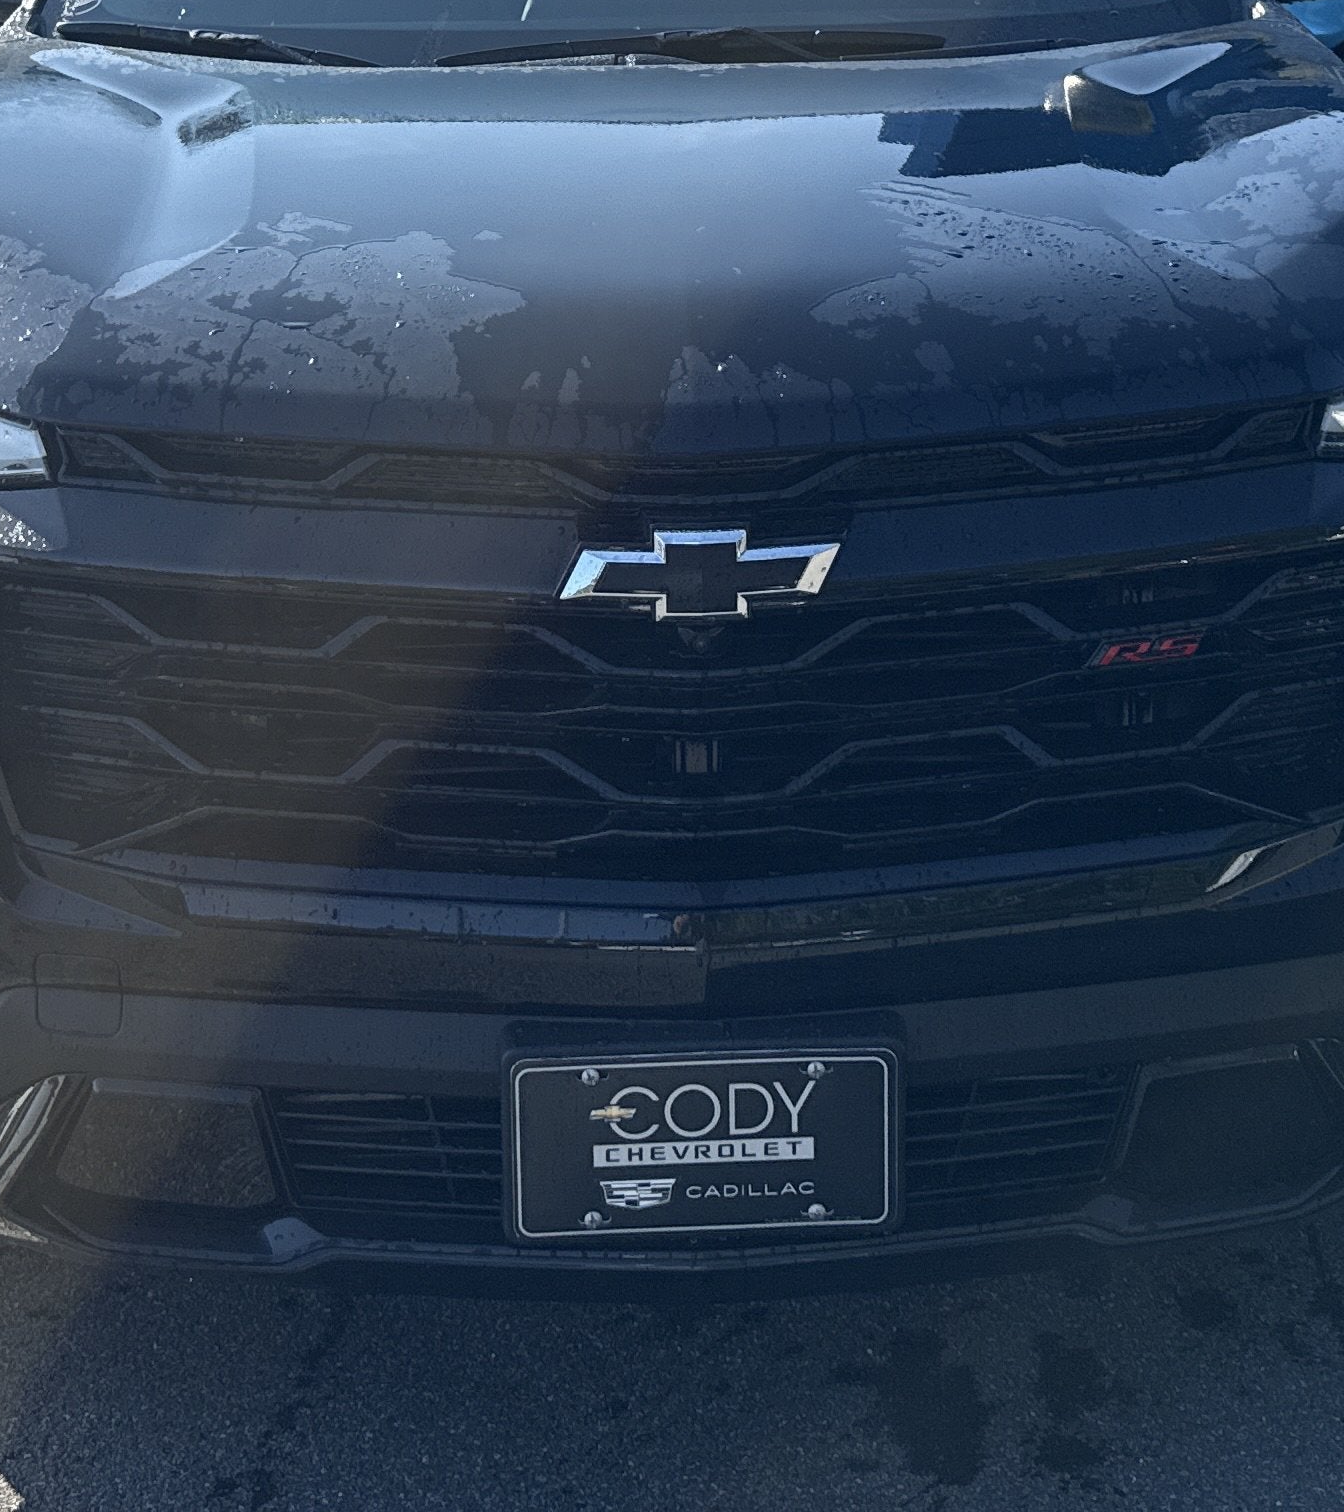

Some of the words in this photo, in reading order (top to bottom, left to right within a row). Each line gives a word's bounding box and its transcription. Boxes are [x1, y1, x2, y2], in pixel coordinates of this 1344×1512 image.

[1099, 635, 1202, 666] RS
[608, 1080, 816, 1140] CODY
[605, 1140, 803, 1163] CHEVROLET
[685, 1180, 816, 1200] CADILLAC
